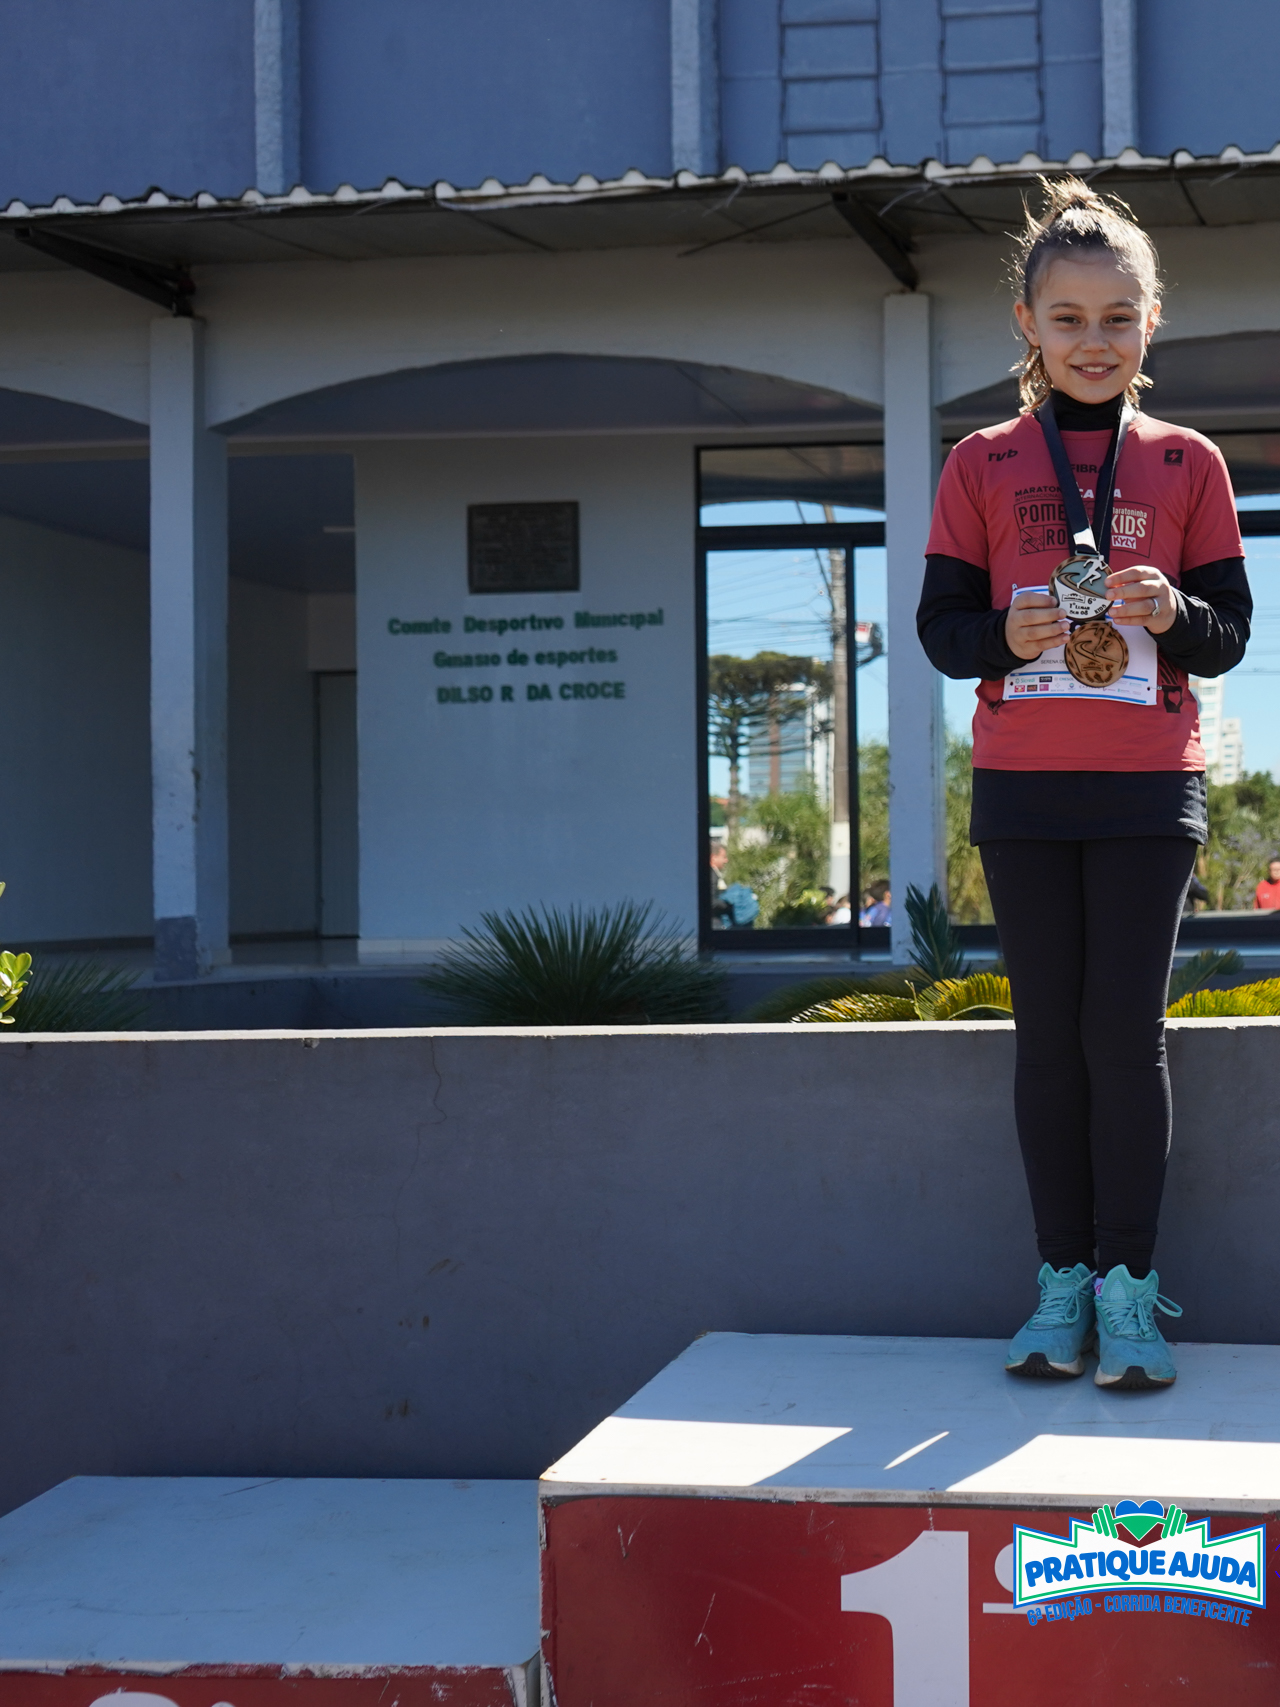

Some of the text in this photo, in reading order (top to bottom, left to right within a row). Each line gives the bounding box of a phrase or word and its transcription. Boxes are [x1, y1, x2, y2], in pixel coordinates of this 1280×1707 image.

[1015, 485, 1063, 498] MARATON
[1112, 507, 1148, 519] aratoninha
[1111, 515, 1147, 538] KIDS
[507, 648, 529, 666] de
[535, 646, 619, 669] esportes
[526, 683, 552, 701] DA
[559, 681, 626, 700] CROCE
